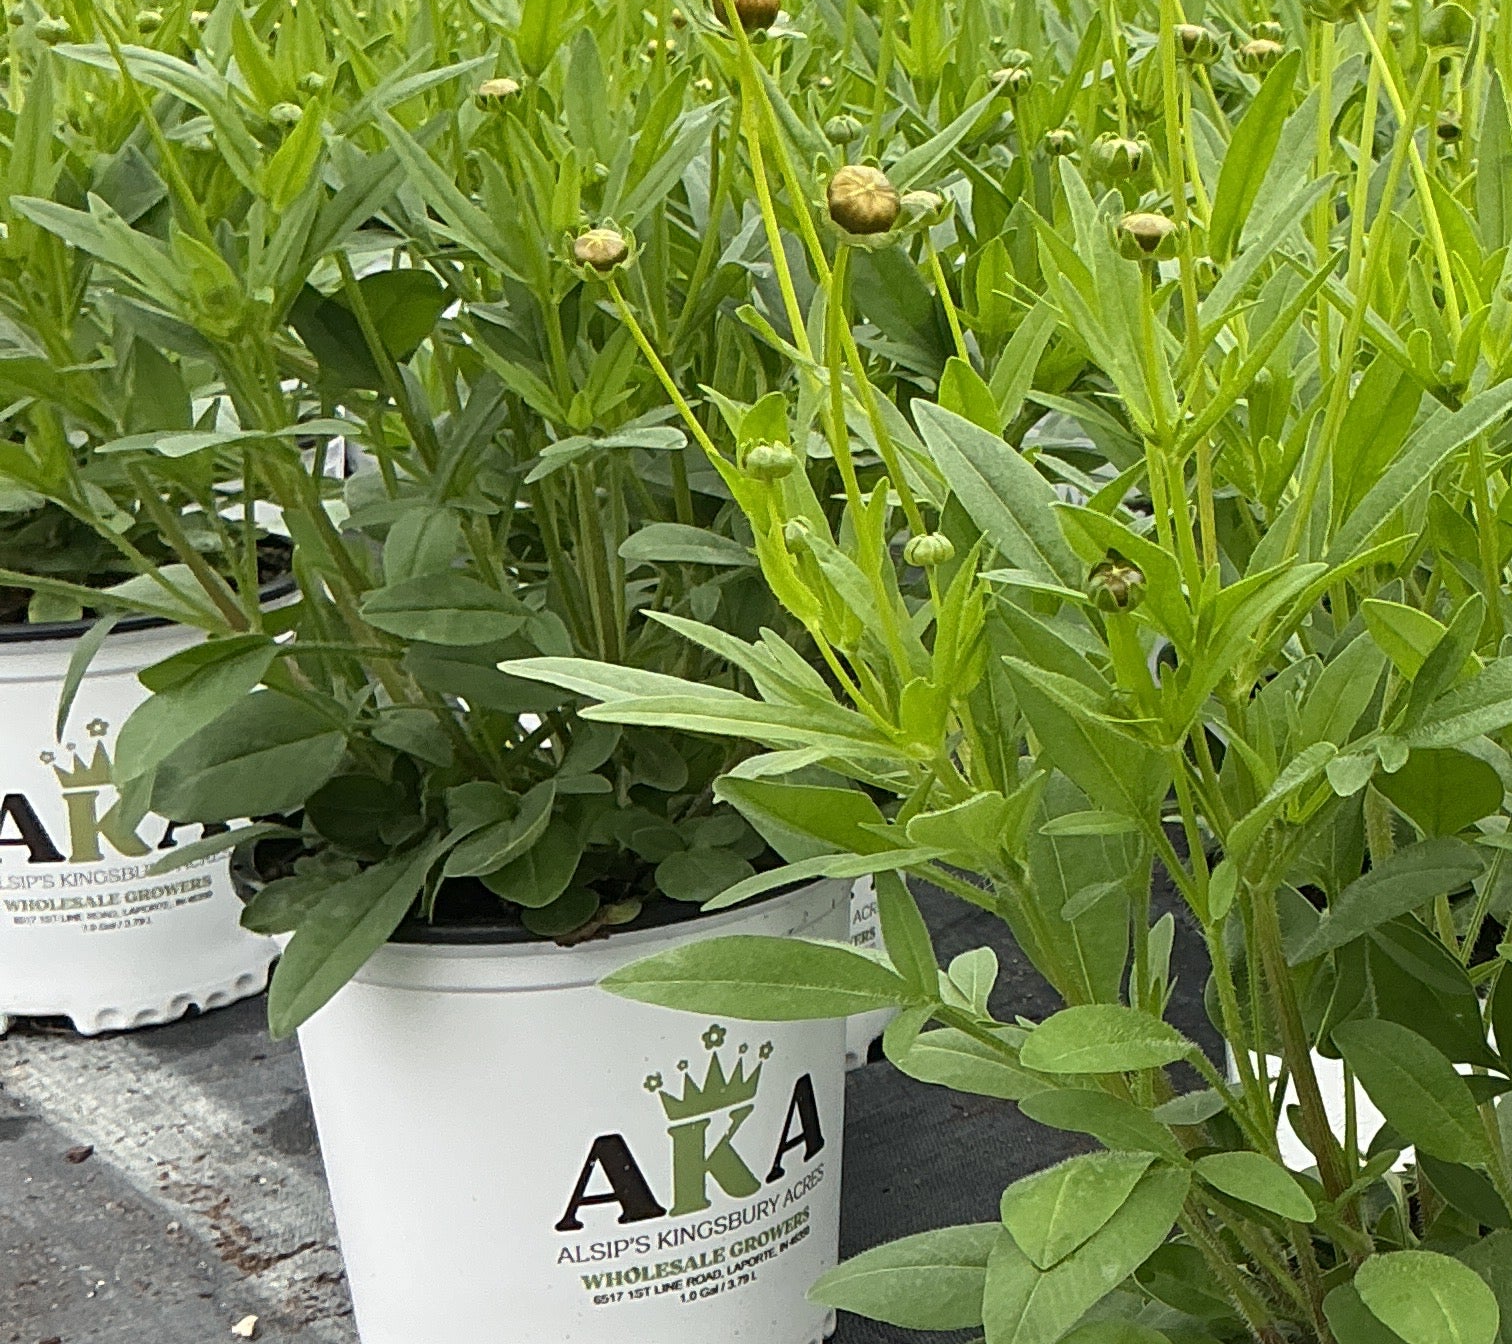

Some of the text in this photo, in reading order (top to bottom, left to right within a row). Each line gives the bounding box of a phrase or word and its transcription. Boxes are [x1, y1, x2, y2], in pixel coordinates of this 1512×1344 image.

[60, 865, 151, 887] KINGSBU
[3, 875, 213, 912] WHOLESALE GROWERS
[853, 901, 879, 924] ACR
[555, 1072, 825, 1232] AKA
[557, 1162, 825, 1264] ALSIP'S KINGSBURY ACRES
[581, 1205, 810, 1290] WHOLESALE GROWERS
[593, 1291, 625, 1305] 6517
[654, 1279, 684, 1295] LINE
[699, 1284, 720, 1298] Gal
